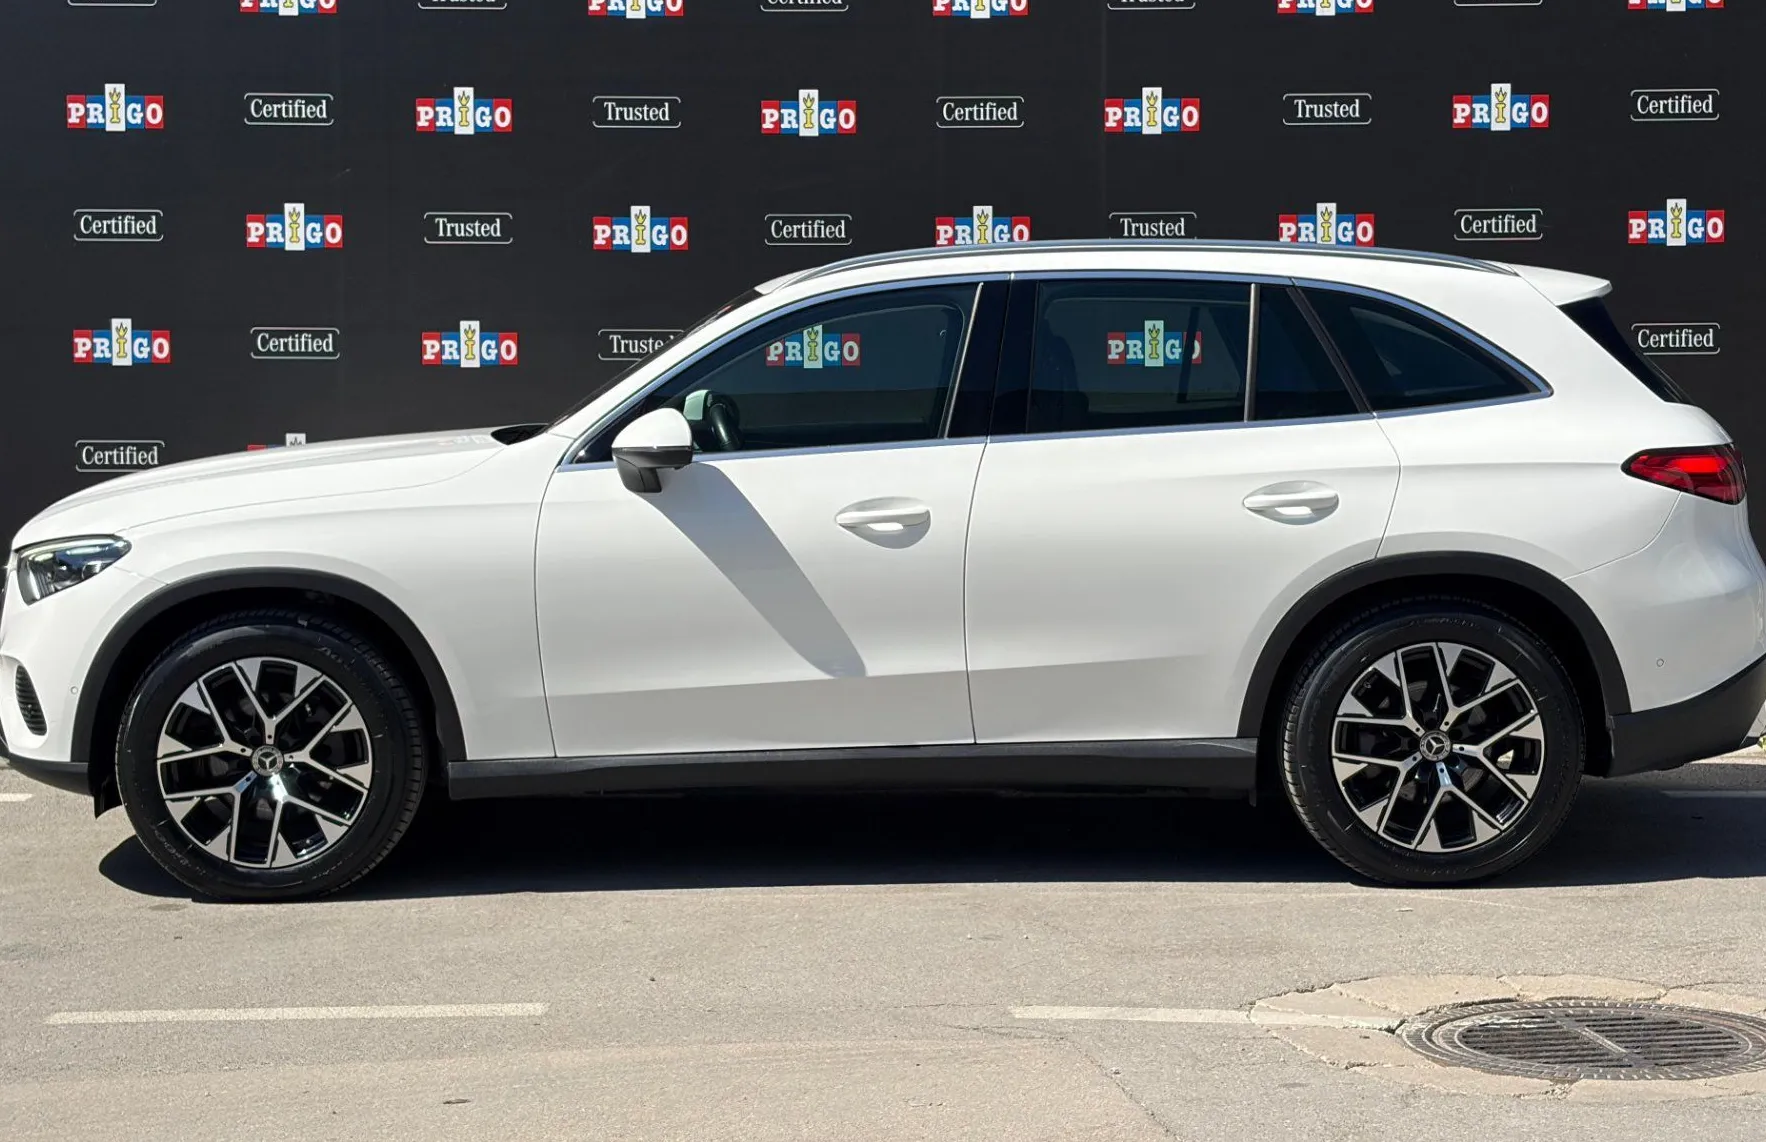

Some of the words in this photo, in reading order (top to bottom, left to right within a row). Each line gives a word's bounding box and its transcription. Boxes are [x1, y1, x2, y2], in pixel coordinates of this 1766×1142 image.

[67, 88, 163, 125] PRIGO
[250, 98, 328, 119] Certified
[416, 91, 511, 128] PRIGO
[603, 101, 670, 120] Trusted
[762, 94, 855, 129] PRIGO
[942, 101, 1018, 120] Certified
[1105, 92, 1198, 127] PRIGO
[1293, 99, 1360, 117] Trusted
[1453, 88, 1548, 124] PRIGO
[1636, 95, 1712, 114] Certified
[79, 214, 157, 234] Certified
[246, 208, 342, 244] PRIGO
[435, 217, 502, 237] Trusted
[594, 211, 687, 246] PRIGO
[770, 219, 846, 239] Certified
[936, 209, 1028, 245] PRIGO
[1120, 217, 1186, 236] Trusted
[1280, 206, 1373, 242] PRIGO
[1461, 213, 1537, 233] Certified
[1629, 204, 1724, 240] PRIGO
[74, 323, 170, 360] PRIGO
[256, 332, 334, 352] Certified
[423, 326, 517, 361] PRIGO
[609, 334, 674, 353] Truste
[767, 327, 860, 362] PRIGO
[1637, 328, 1714, 348] Certified
[82, 445, 159, 465] Certified
